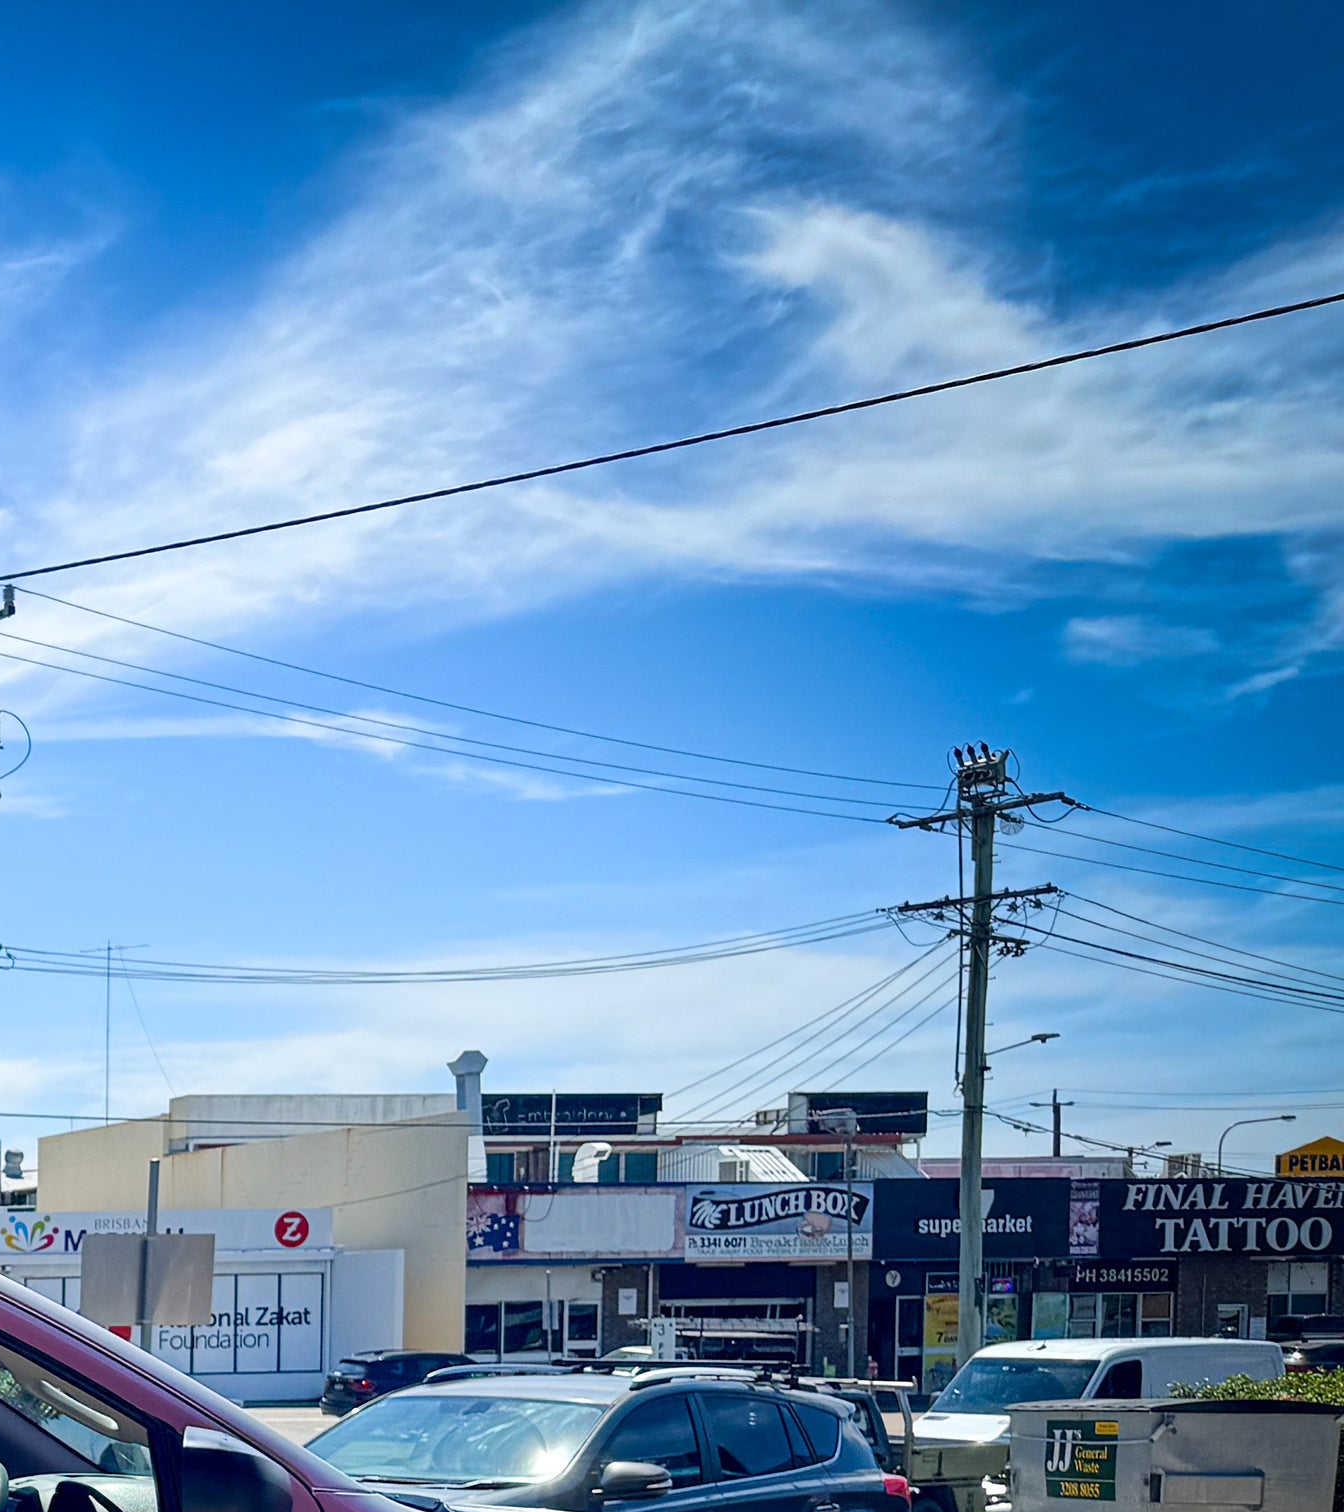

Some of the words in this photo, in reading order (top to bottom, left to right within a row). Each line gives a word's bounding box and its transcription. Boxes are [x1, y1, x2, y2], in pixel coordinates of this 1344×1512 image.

[1289, 1155, 1344, 1171] PETBA
[1122, 1183, 1230, 1210] FINAL
[727, 1192, 806, 1226] LUNCH
[810, 1190, 860, 1221] BOX
[918, 1214, 1032, 1238] supearket
[1155, 1216, 1333, 1253] TATTOO
[700, 1237, 721, 1248] 3341
[724, 1237, 746, 1248] 6071
[1076, 1266, 1096, 1282] PH
[1099, 1268, 1169, 1282] 38415502
[255, 1306, 311, 1327] Zakat
[158, 1329, 270, 1350] Foundation
[1074, 1446, 1108, 1460] General
[1074, 1459, 1100, 1473] Waste
